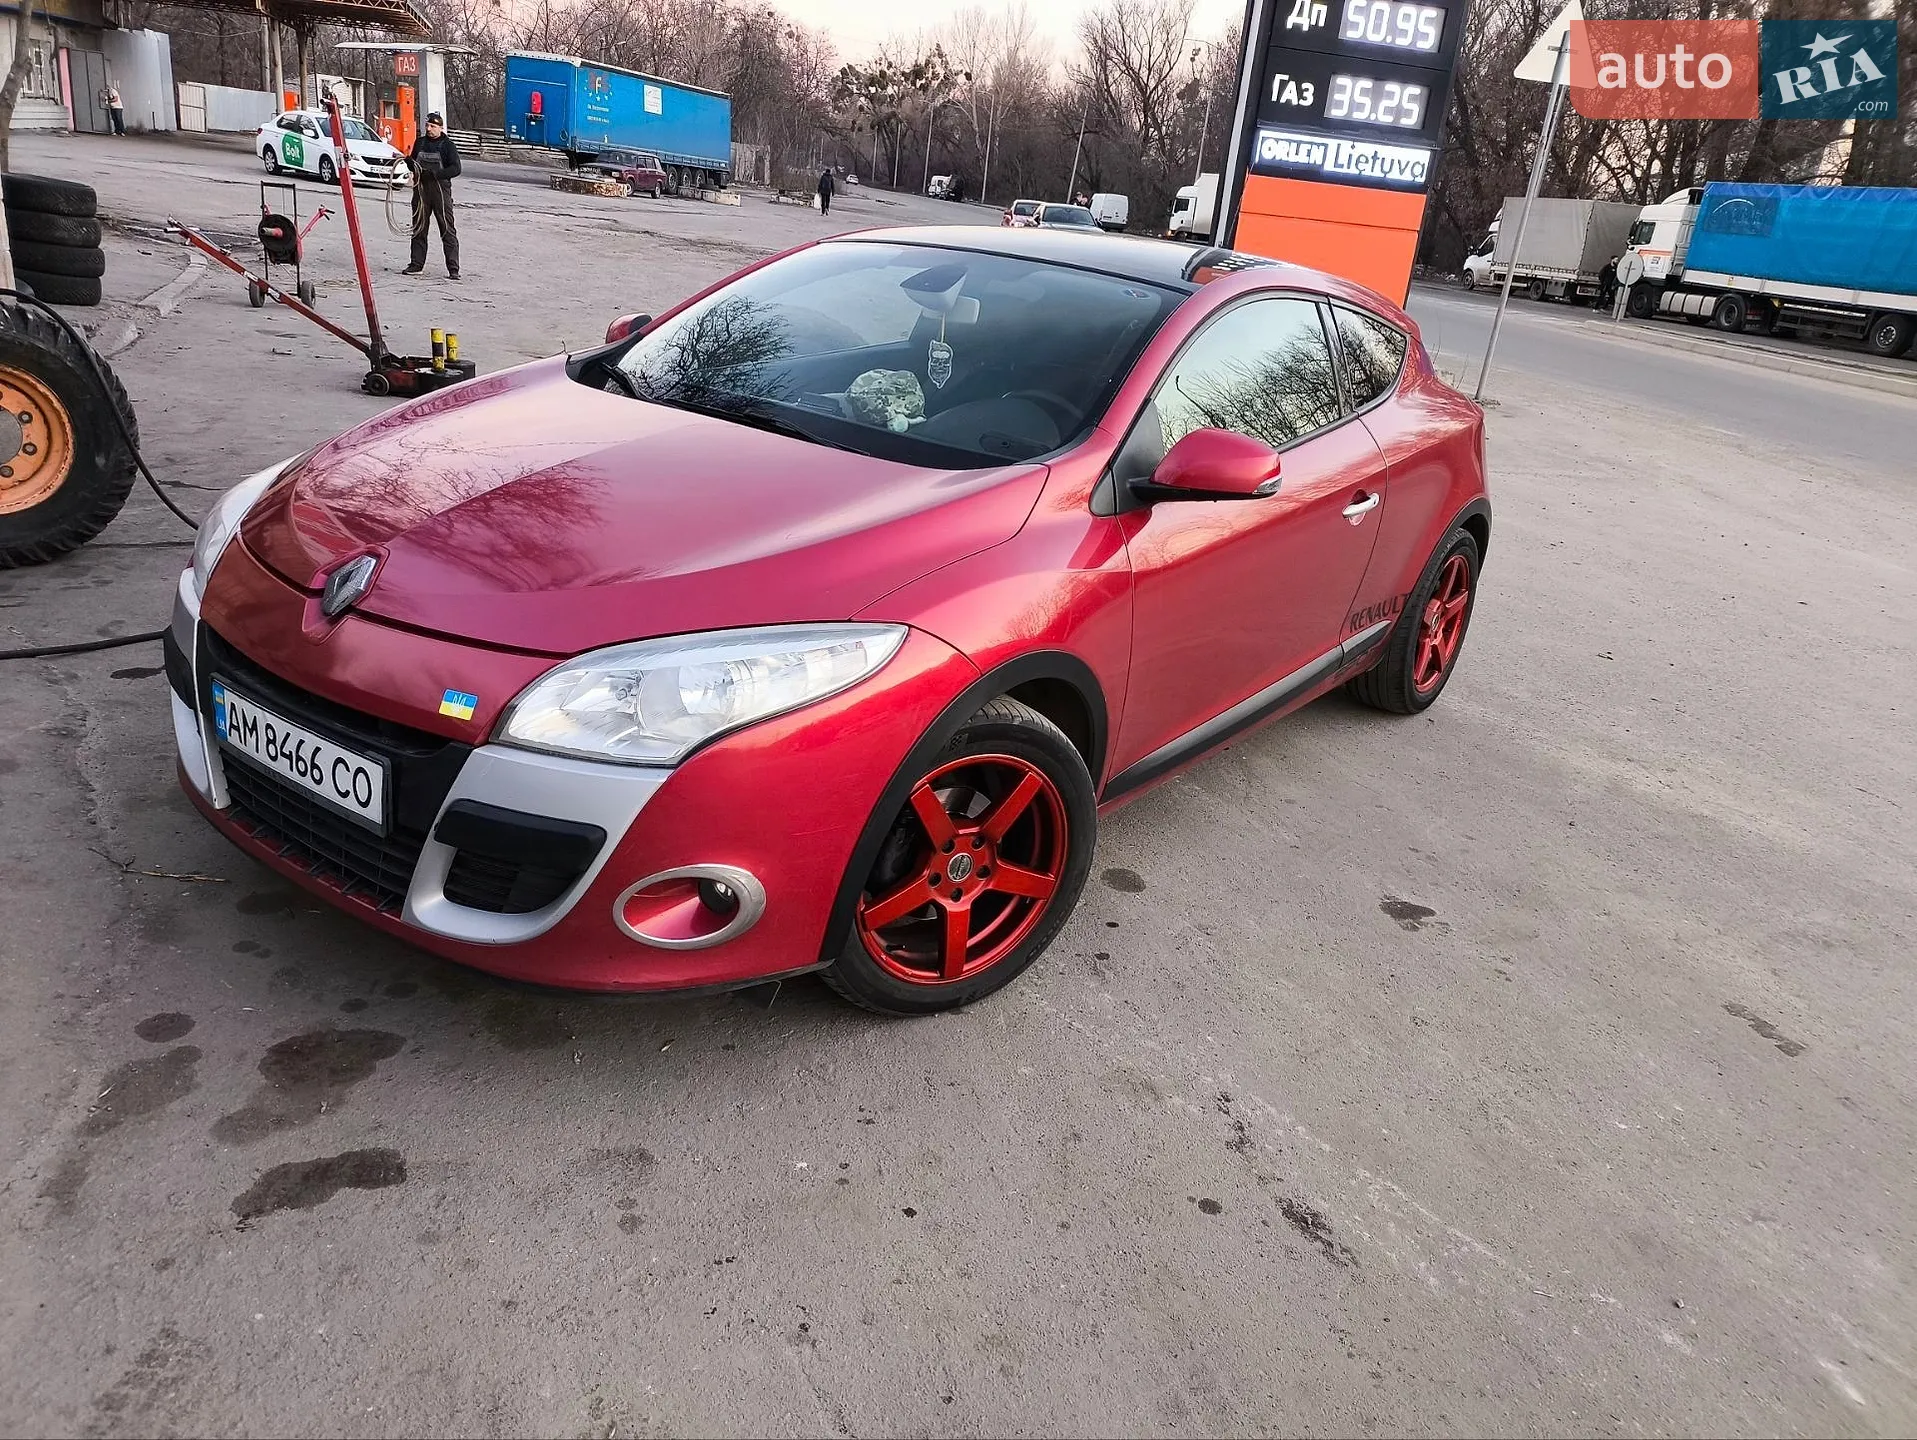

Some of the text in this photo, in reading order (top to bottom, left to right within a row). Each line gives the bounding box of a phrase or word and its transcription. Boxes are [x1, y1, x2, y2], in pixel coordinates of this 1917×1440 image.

[1345, 0, 1438, 49] 50.95
[396, 56, 416, 72] ГАЗ
[1271, 73, 1421, 126] ГАЗ 35.25
[1260, 138, 1326, 166] ORLEN
[228, 702, 260, 754] AM
[264, 722, 325, 786] 8466
[331, 756, 373, 809] CO
